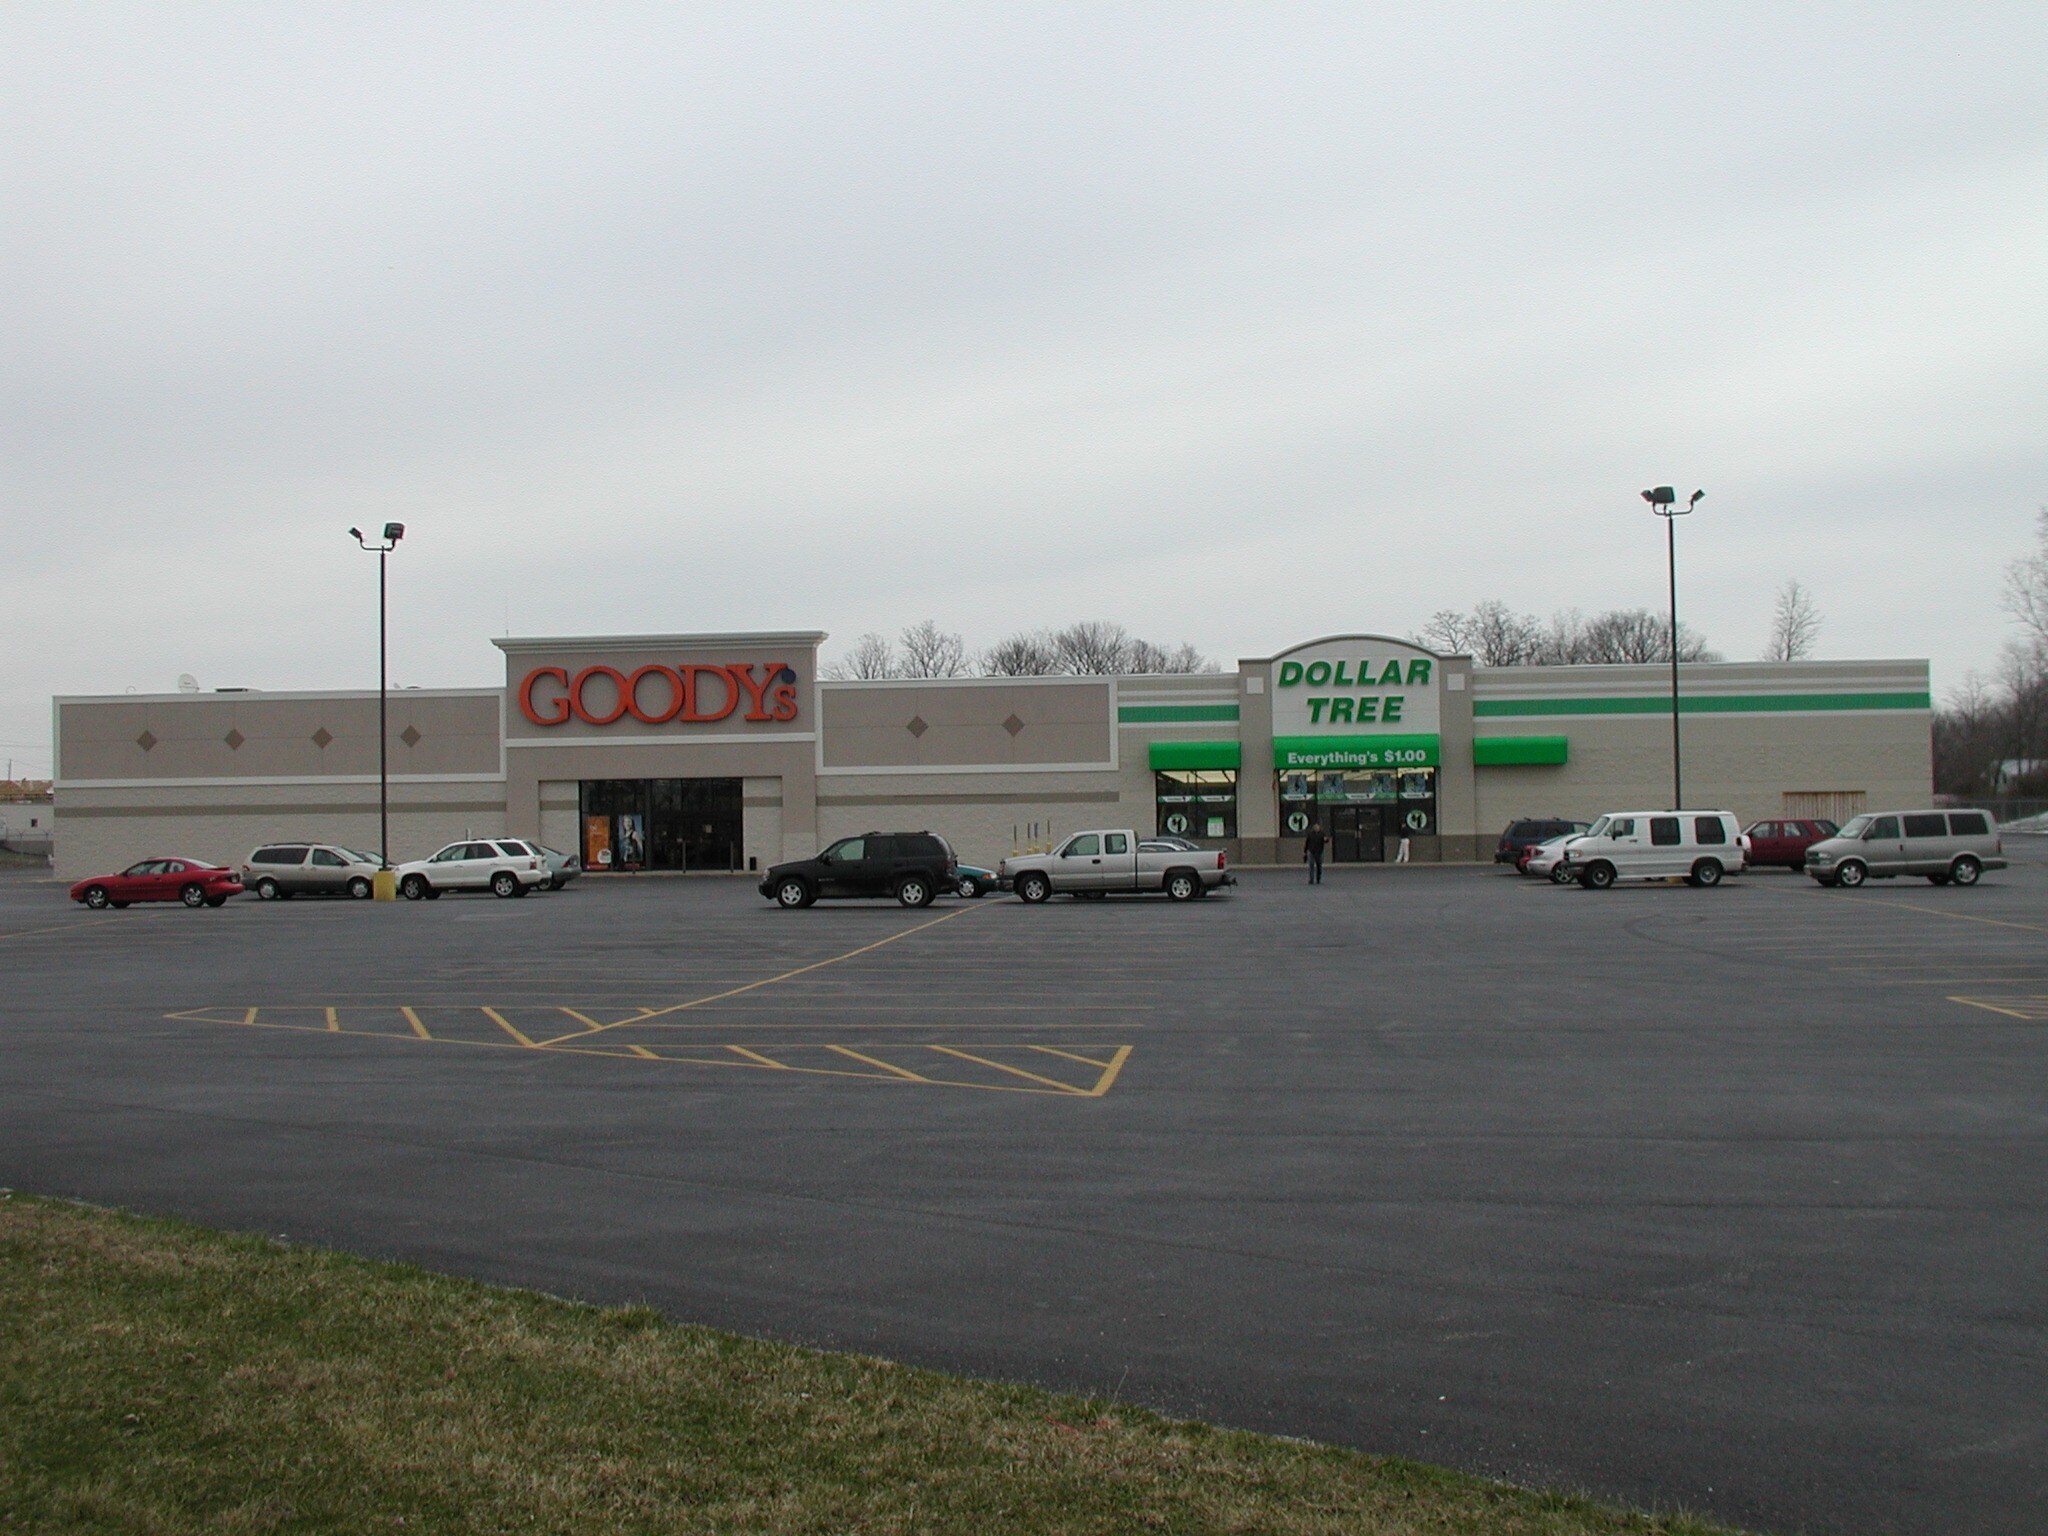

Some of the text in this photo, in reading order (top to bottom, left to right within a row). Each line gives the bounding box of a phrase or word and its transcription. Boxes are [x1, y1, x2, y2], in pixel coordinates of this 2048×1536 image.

[1278, 659, 1432, 686] DOLLAR
[1306, 696, 1405, 723] TREE
[1287, 750, 1426, 765] Everything's $1.00
